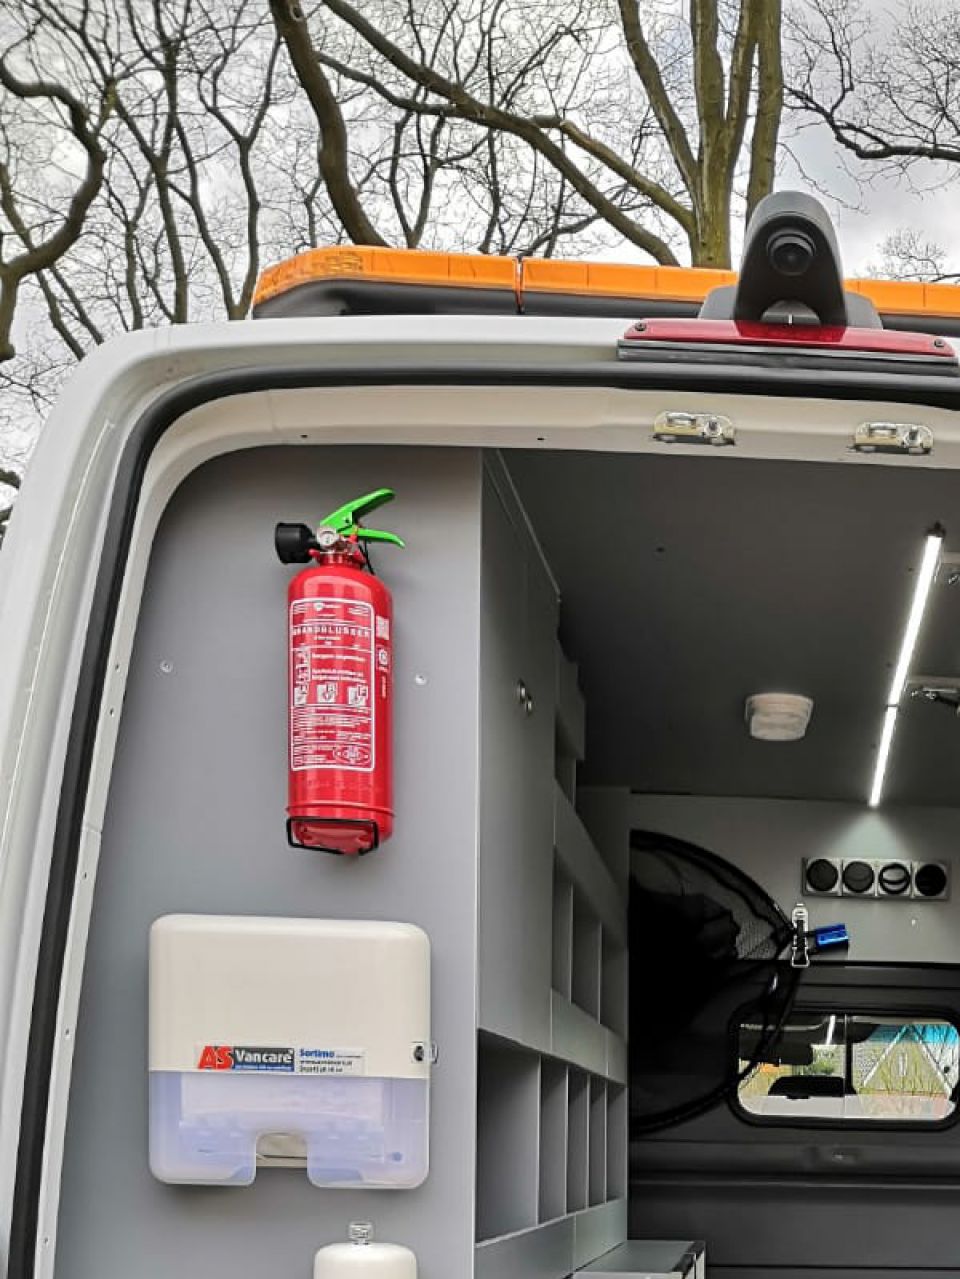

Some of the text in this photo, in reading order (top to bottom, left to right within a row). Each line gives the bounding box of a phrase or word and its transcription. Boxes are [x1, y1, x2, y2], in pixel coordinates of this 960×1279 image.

[198, 1046, 292, 1070] AS Vancare
[300, 1049, 335, 1058] Sortimo
